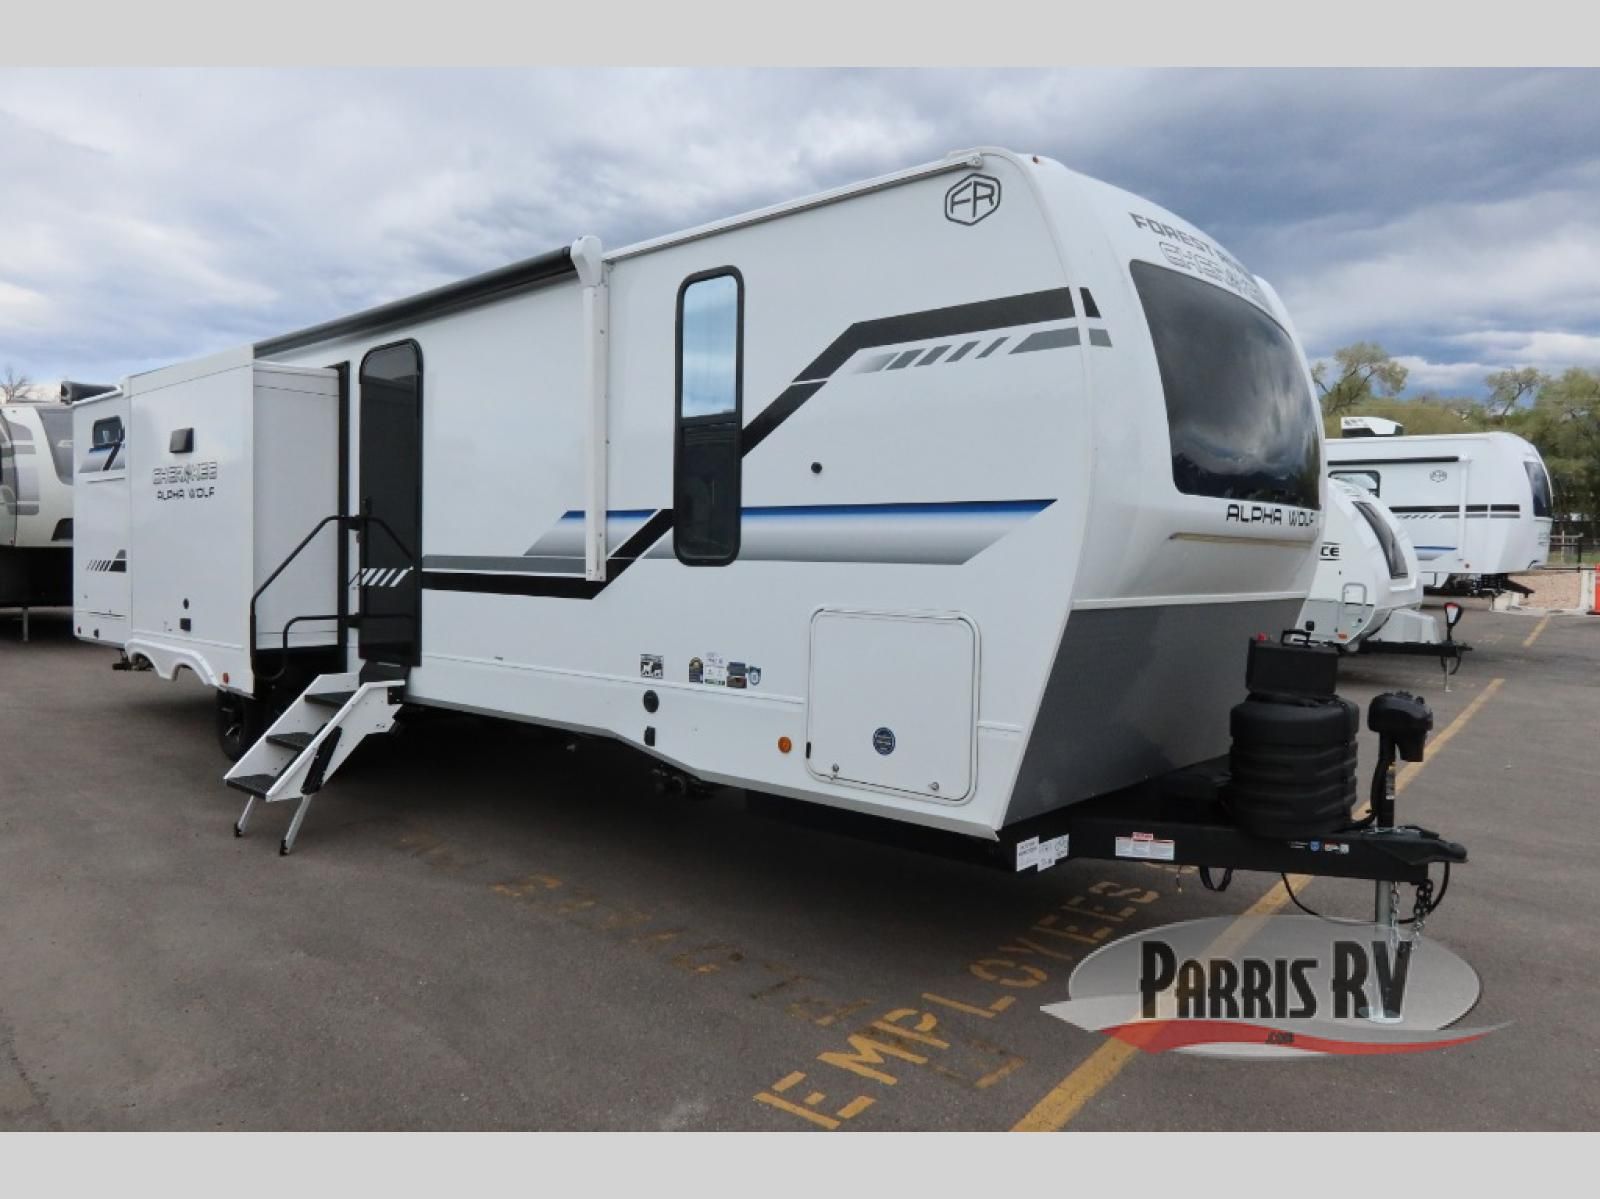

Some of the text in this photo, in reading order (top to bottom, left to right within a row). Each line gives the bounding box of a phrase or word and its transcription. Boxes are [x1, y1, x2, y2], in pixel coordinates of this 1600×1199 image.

[1128, 211, 1215, 256] FOREST
[156, 487, 215, 501] ALPHA WOLF
[1225, 503, 1315, 527] ALPHA WOLF
[754, 880, 1160, 1131] EMPLOYEES
